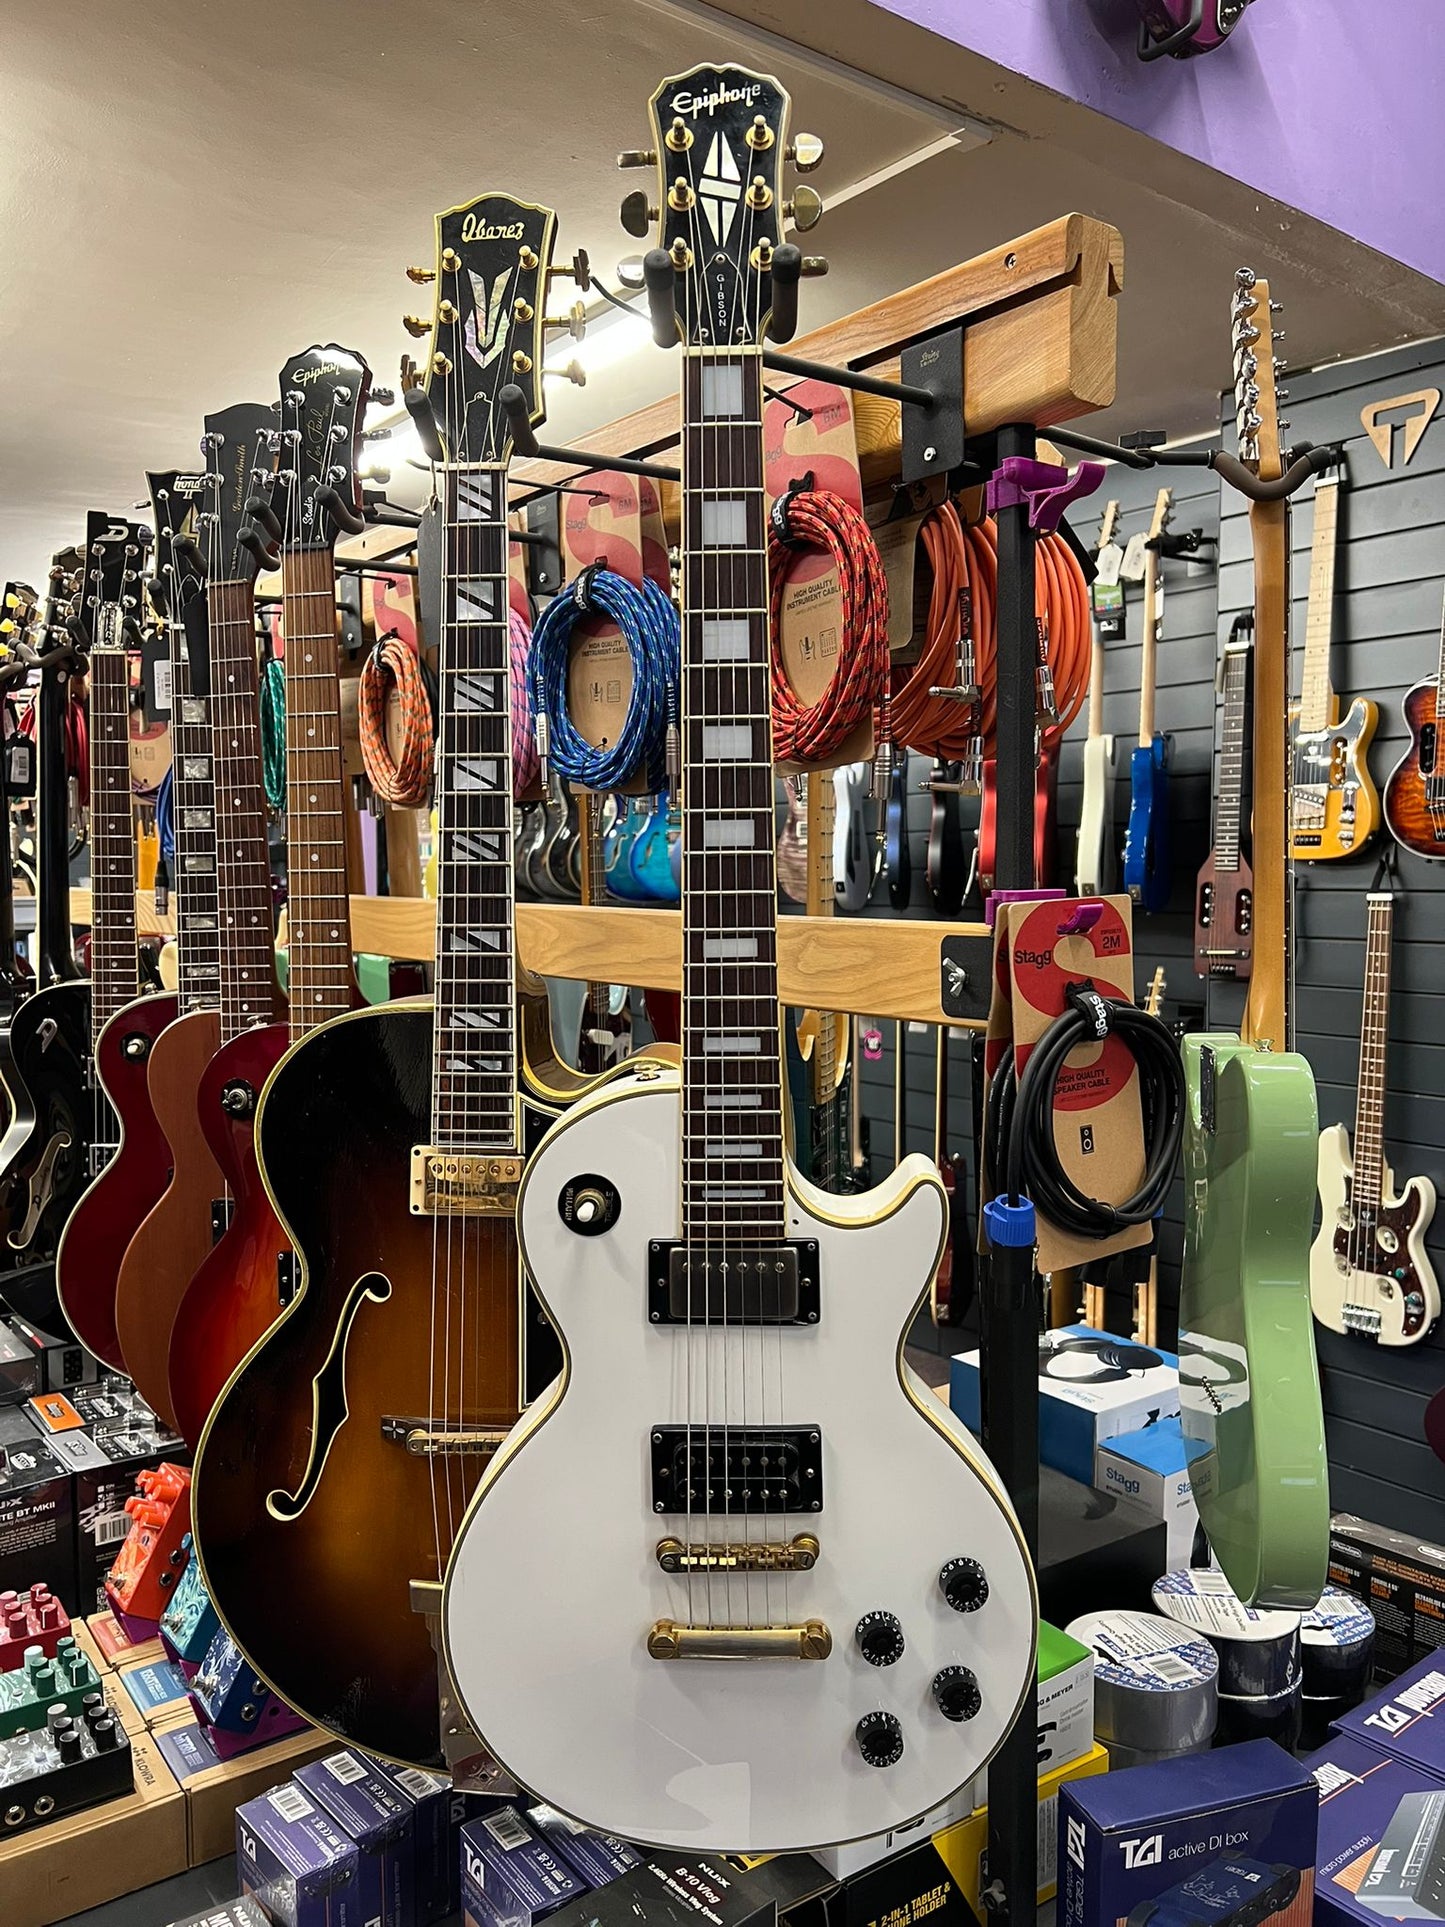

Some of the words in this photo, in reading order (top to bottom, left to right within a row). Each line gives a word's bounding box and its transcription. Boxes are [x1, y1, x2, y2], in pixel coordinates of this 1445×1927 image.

[669, 82, 761, 119] Epiphone
[461, 213, 525, 243] Ibanez
[716, 273, 727, 327] GIBSON
[291, 360, 342, 387] Epiphon
[766, 444, 783, 464] agg
[303, 496, 314, 526] Studio
[566, 518, 588, 533] Stagg
[577, 575, 588, 610] stagg
[793, 586, 807, 599] HIGH
[807, 578, 834, 595] QUALITY
[786, 593, 822, 612] INSTRUMENT
[581, 648, 608, 657] INSTRUMENT
[608, 645, 628, 656] CABLE
[588, 640, 601, 649] HIGH
[601, 638, 622, 649] QUALITY
[1102, 935, 1121, 950] 2M
[1014, 949, 1052, 969] Stagg
[1089, 994, 1109, 1037] stagg
[1055, 1073, 1075, 1085] HIGH
[1075, 1068, 1106, 1083] QUALITY
[1087, 1077, 1111, 1089] CABLE
[1106, 1466, 1140, 1494] Stagg
[1176, 1479, 1193, 1495] Sta
[16, 1507, 31, 1519] BT
[32, 1500, 56, 1514] MKII
[1177, 1646, 1208, 1660] EAGLE
[1103, 1661, 1133, 1676] EAGLE
[1051, 1683, 1074, 1701] MEYER
[1363, 1704, 1412, 1733] TGI
[134, 1753, 156, 1786] KLOWRA
[240, 1825, 257, 1863] TGI
[1067, 1815, 1086, 1870] TGI
[1119, 1834, 1164, 1870] TGI
[1168, 1841, 1206, 1861] active
[1208, 1835, 1222, 1850] DI
[1225, 1831, 1249, 1846] box
[1319, 1860, 1337, 1877] micro
[1352, 1835, 1373, 1852] supply
[463, 1841, 485, 1890] TGI
[697, 1862, 732, 1889] NUX
[674, 1867, 701, 1886] B-10
[696, 1883, 722, 1905] Vlog
[665, 1877, 691, 1899] Wireless
[688, 1895, 703, 1910] Vlog
[700, 1906, 724, 1926] System
[881, 1903, 909, 1927] 2-IN-1
[910, 1884, 943, 1911] TABLET
[943, 1881, 952, 1893] &
[912, 1894, 947, 1921] HOLDER
